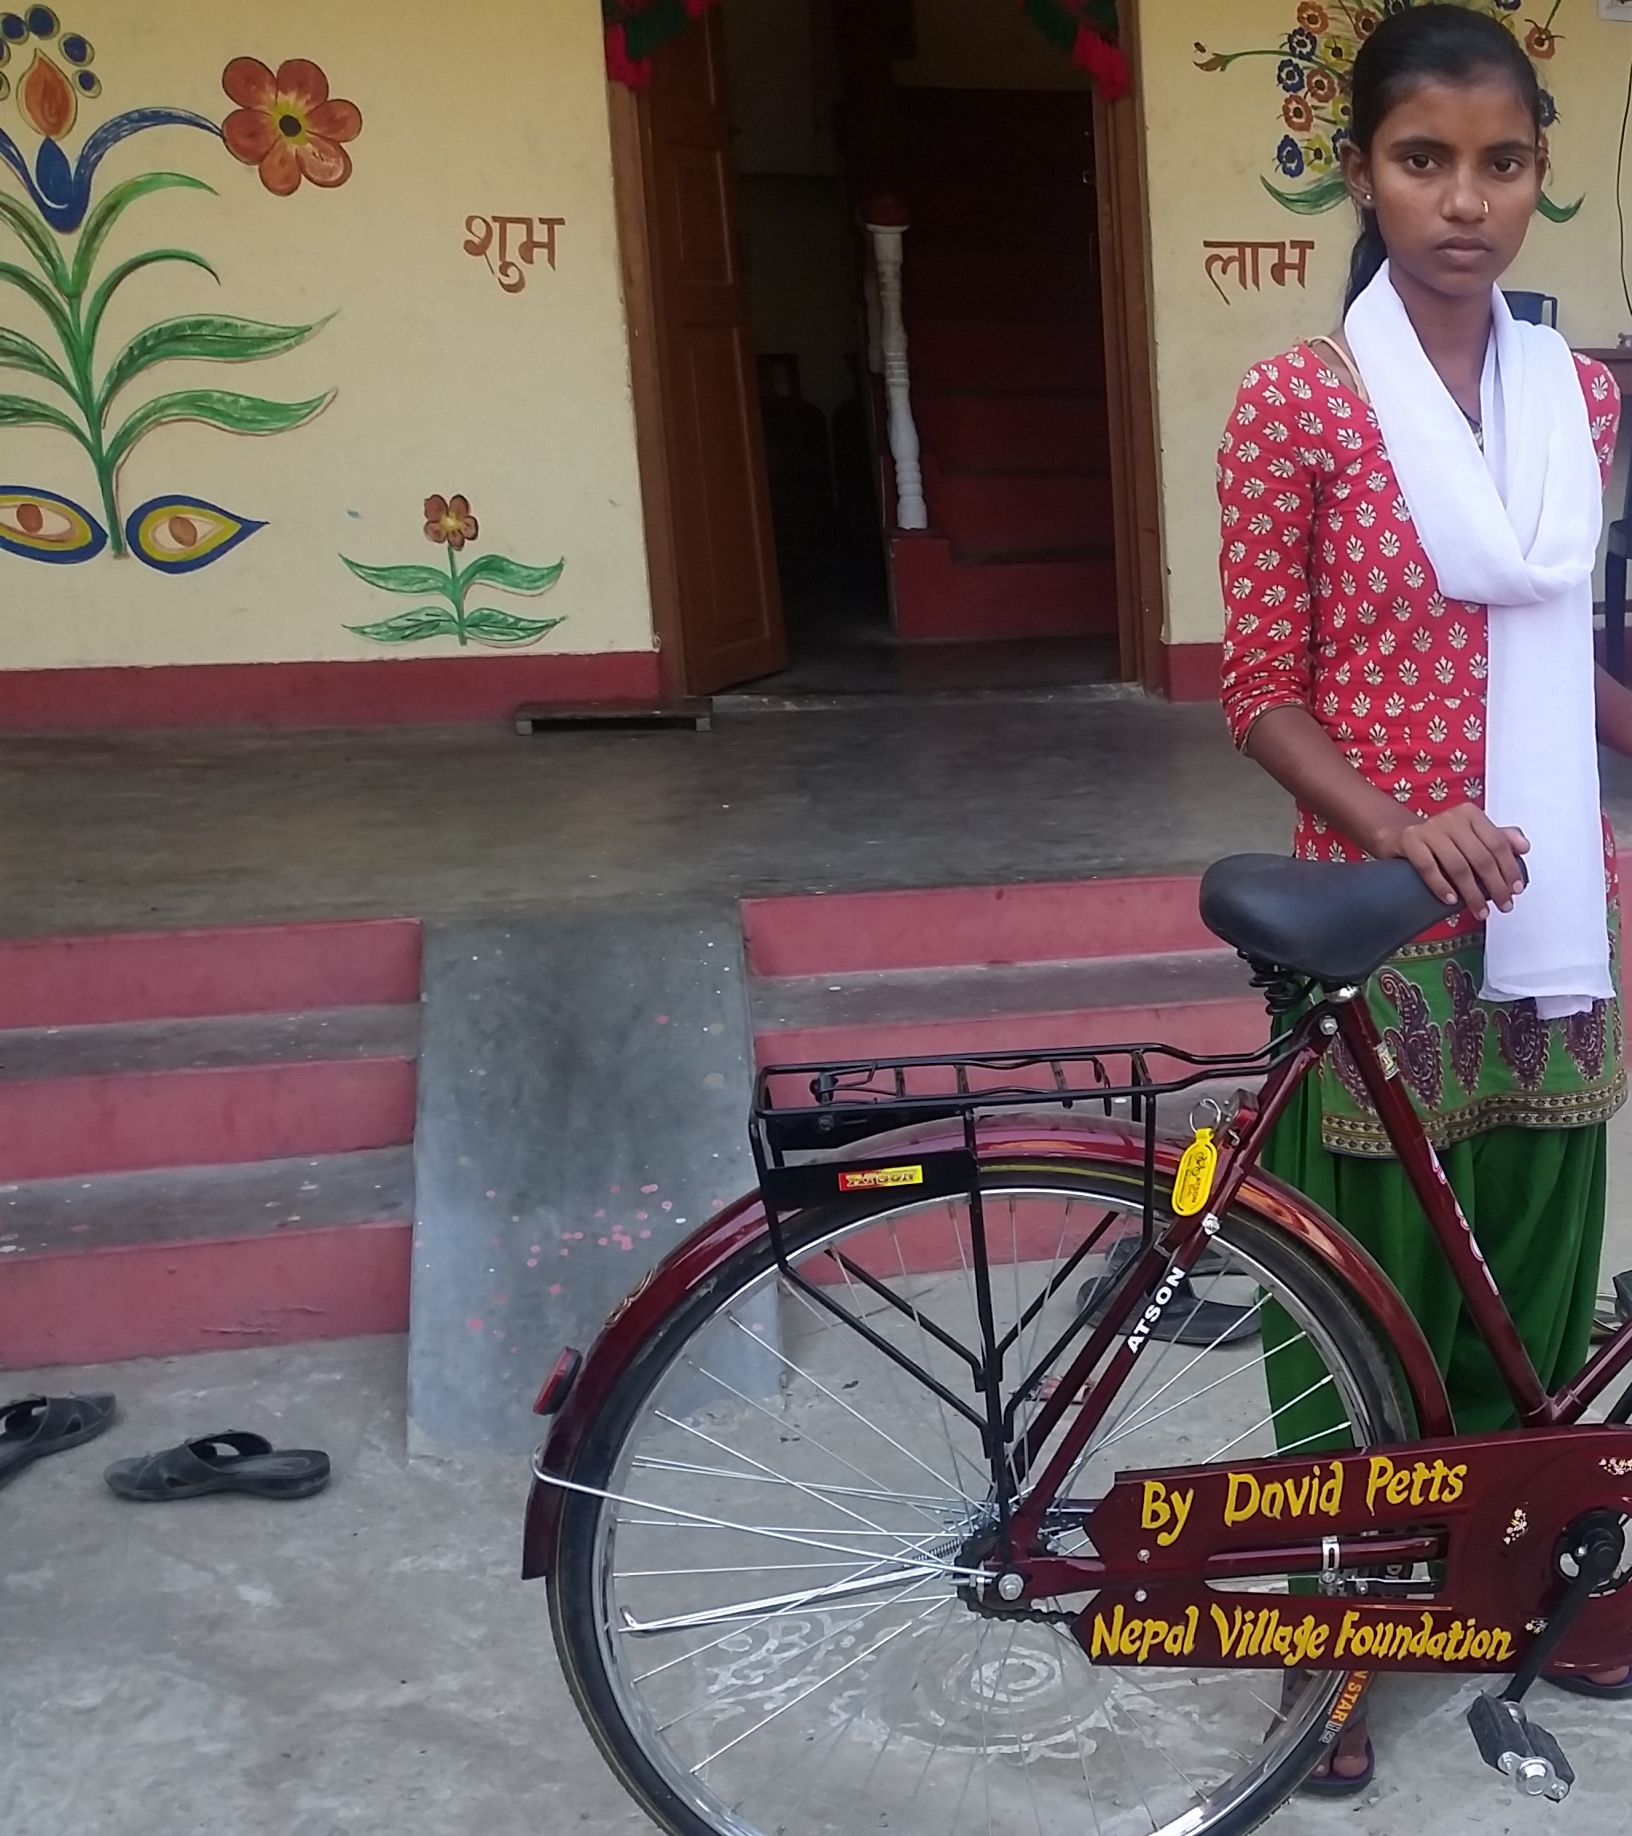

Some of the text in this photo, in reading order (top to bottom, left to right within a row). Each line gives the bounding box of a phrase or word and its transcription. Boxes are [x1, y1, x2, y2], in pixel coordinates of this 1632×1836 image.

[463, 215, 566, 294] शुभ
[1203, 240, 1315, 306] लाभ
[1127, 1266, 1186, 1354] ATSON
[1142, 1457, 1467, 1546] By David Petts
[1091, 1604, 1516, 1665] Nepal Village Foundation
[1332, 1682, 1362, 1722] STAR
